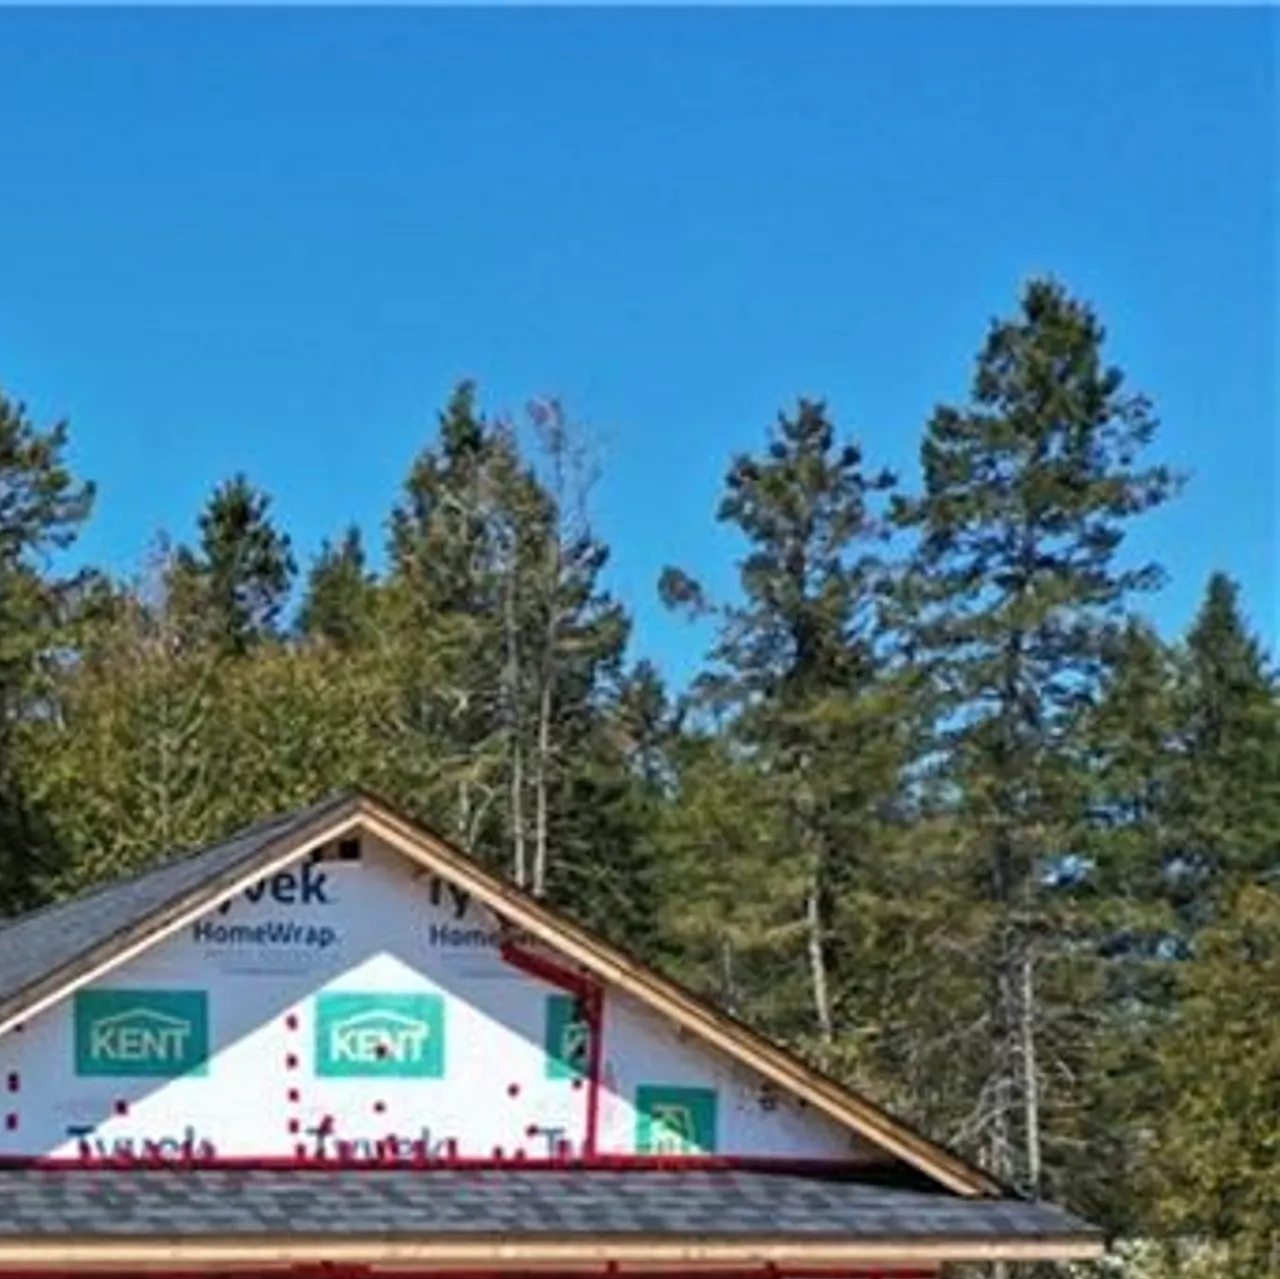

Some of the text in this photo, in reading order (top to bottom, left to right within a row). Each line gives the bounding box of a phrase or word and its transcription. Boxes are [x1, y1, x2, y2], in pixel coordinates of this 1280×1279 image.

[243, 859, 329, 905] vek
[91, 1027, 189, 1060] KENT
[330, 1028, 427, 1062] KENT
